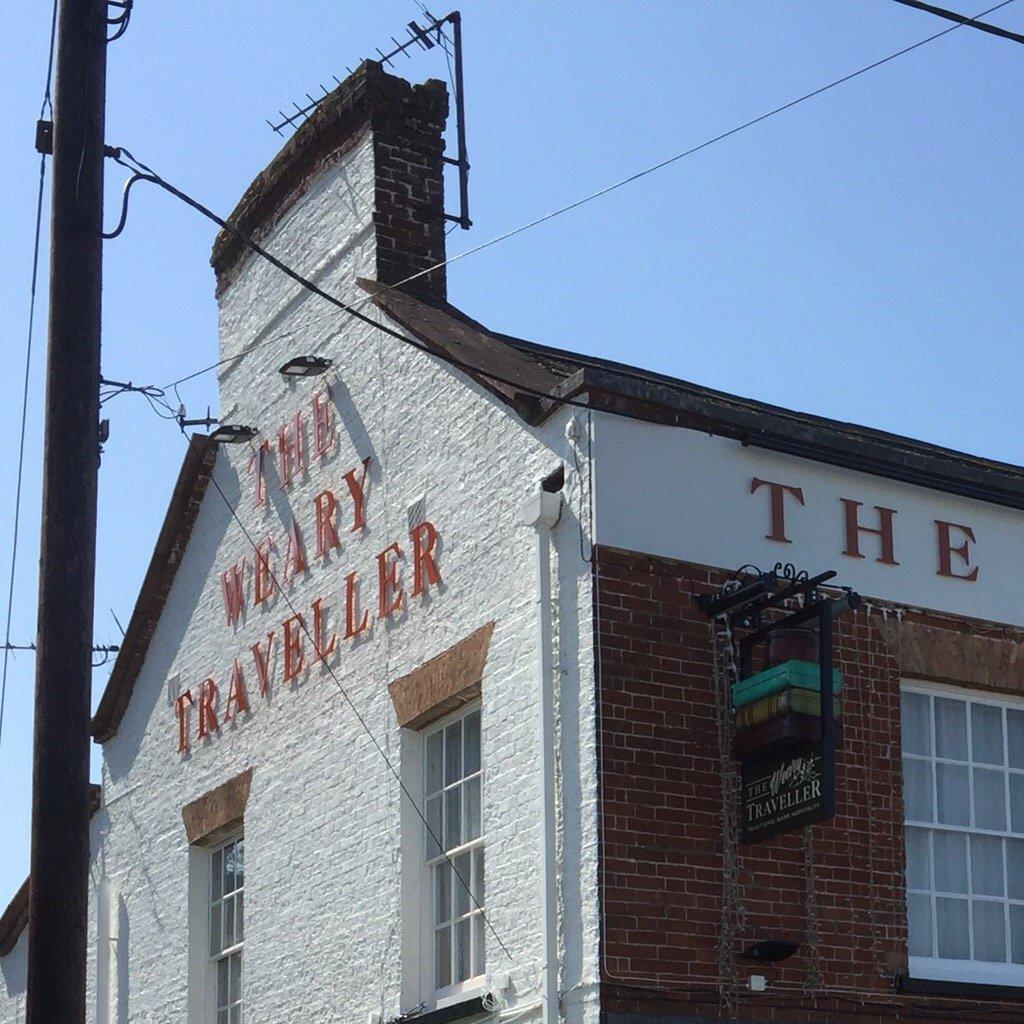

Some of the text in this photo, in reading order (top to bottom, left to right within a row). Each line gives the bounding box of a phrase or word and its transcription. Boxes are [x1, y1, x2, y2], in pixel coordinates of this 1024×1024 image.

[248, 386, 334, 510] THE
[221, 457, 371, 627] WEARY
[750, 477, 979, 582] THE
[174, 520, 442, 754] TRAVELLER
[746, 779, 822, 821] TRAVELLER
[748, 781, 768, 797] THE
